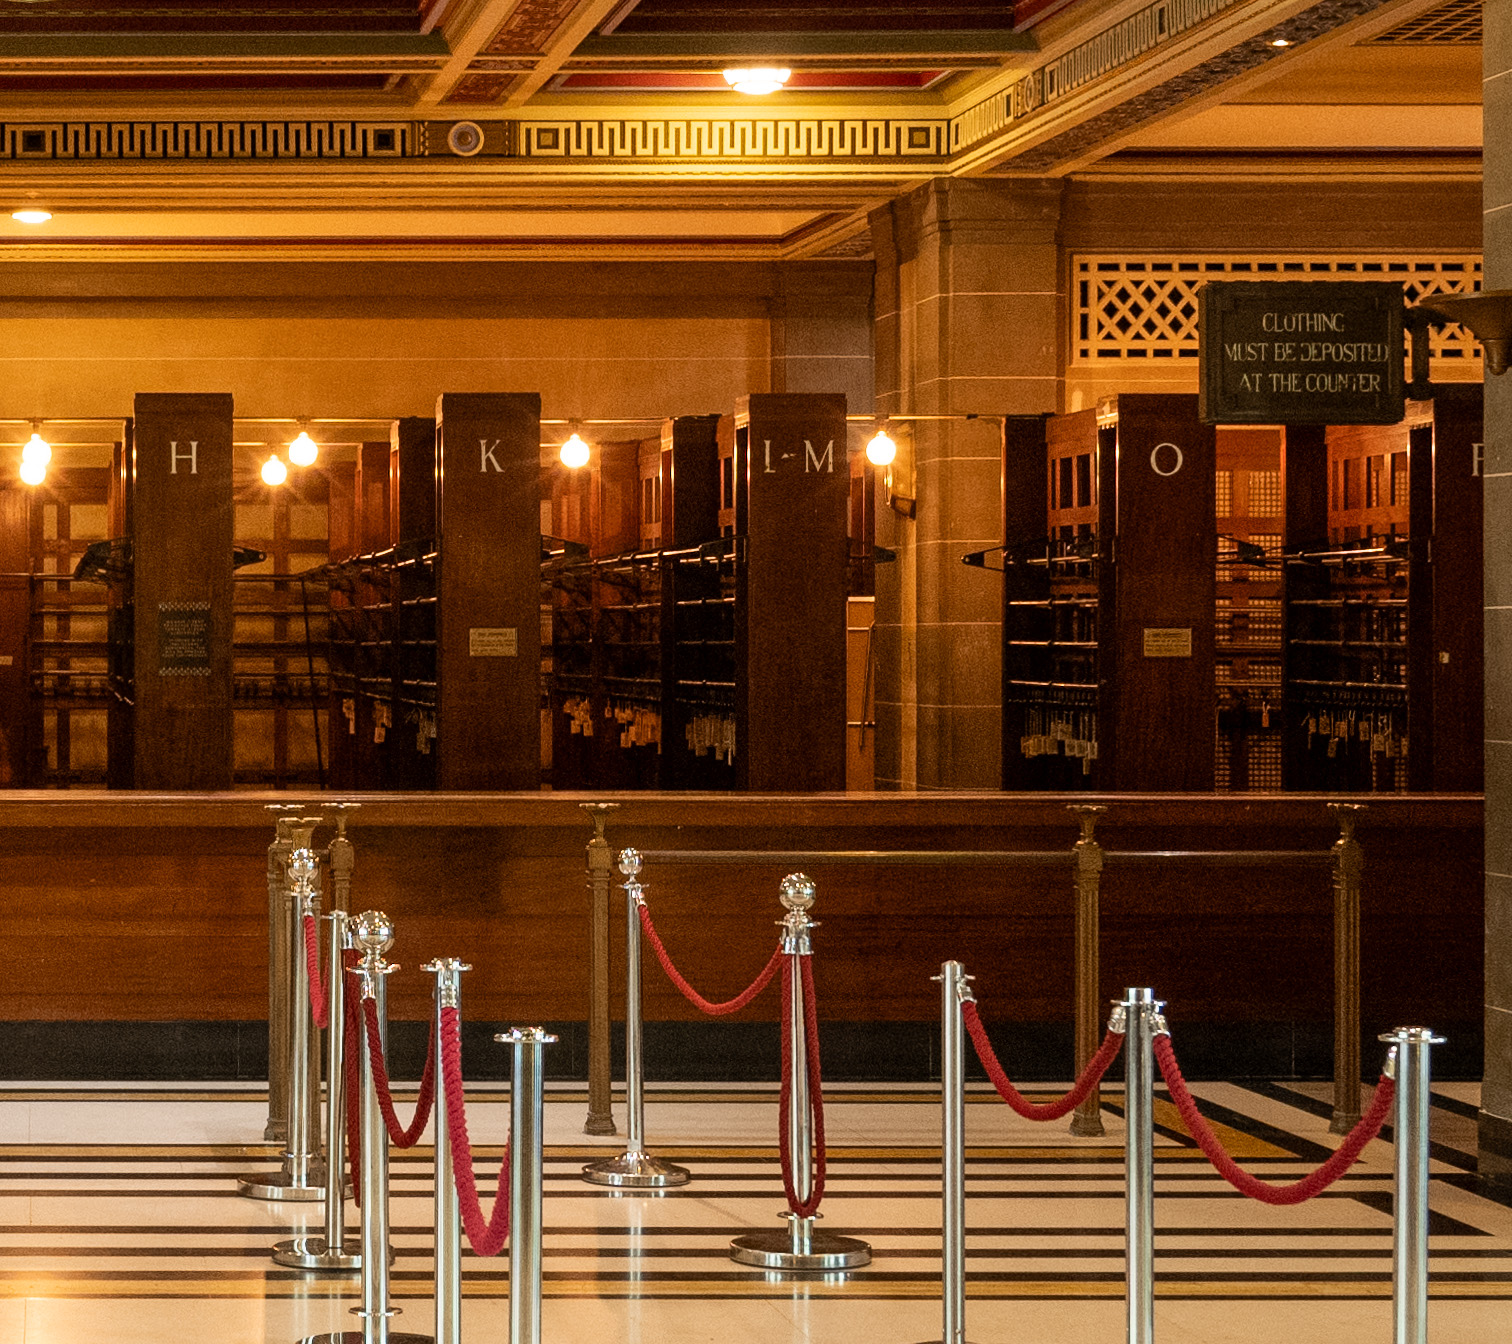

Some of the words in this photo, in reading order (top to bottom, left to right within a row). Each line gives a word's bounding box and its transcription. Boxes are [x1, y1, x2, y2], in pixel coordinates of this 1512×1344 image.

[1262, 312, 1345, 333] CLOTHING
[1224, 342, 1269, 362] MUST
[1274, 342, 1296, 362] BE
[1300, 342, 1389, 362] DEPOSITED
[1239, 373, 1263, 393] AT
[1268, 373, 1302, 393] THE
[1305, 373, 1382, 393] COUNTER
[169, 441, 199, 475] H
[480, 439, 506, 473] K
[1150, 442, 1184, 477] O
